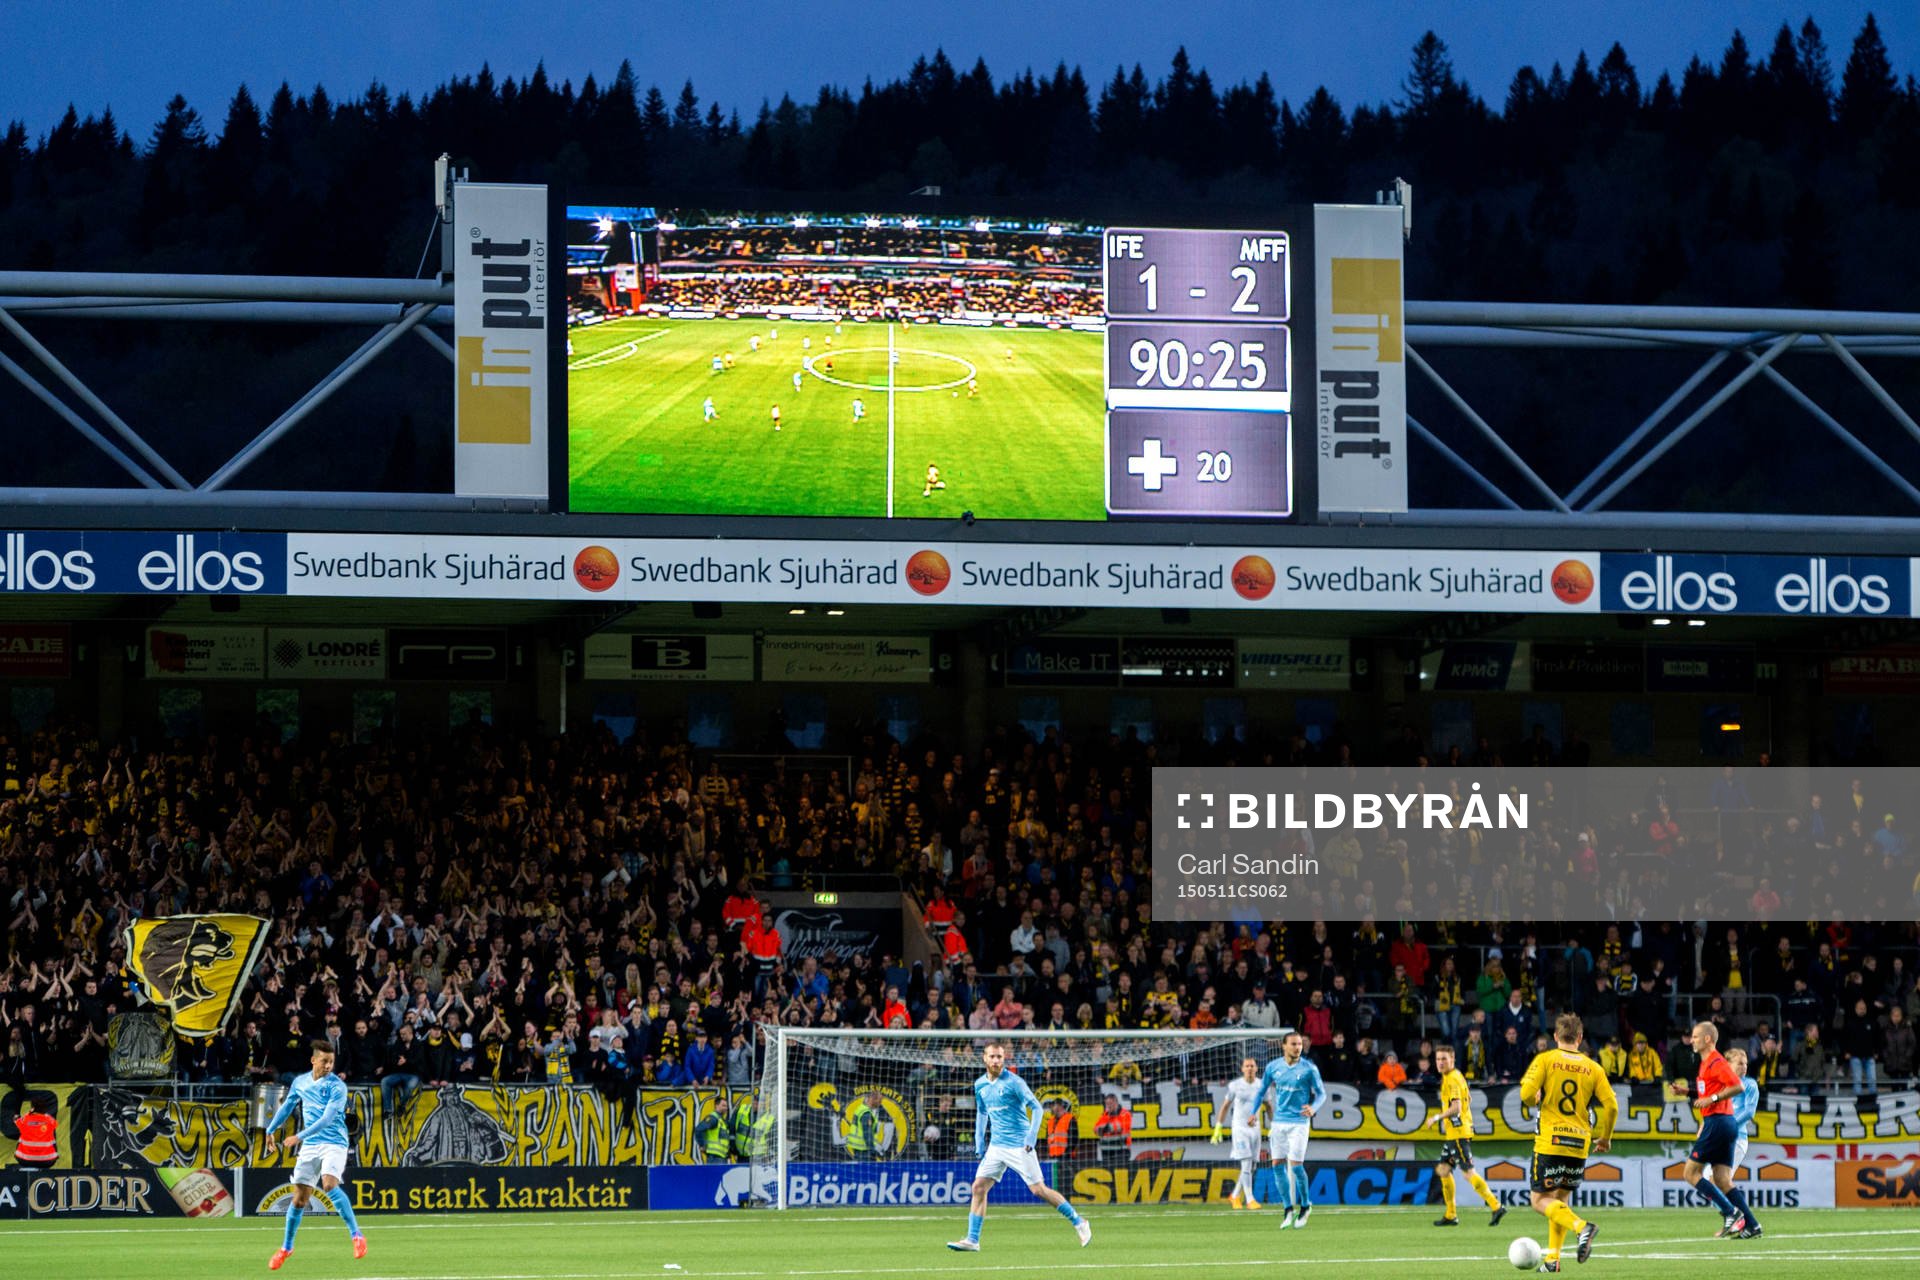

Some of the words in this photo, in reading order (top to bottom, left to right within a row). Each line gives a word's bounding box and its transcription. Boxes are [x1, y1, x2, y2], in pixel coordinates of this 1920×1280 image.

[1109, 235, 1144, 258] IFE
[1240, 238, 1286, 261] MFF
[533, 238, 545, 311] interiör
[1138, 264, 1157, 310] 1
[1231, 266, 1259, 312] 2
[1129, 339, 1267, 389] 90:25
[1320, 388, 1330, 459] interiör
[1196, 451, 1232, 481] 20
[0, 533, 96, 591] llos
[137, 534, 264, 592] ellos
[293, 551, 437, 579] Swedbank
[444, 554, 565, 586] Sjuhärad
[630, 556, 772, 583] Swedbank
[779, 558, 897, 590] Sjuhärad
[961, 560, 1100, 587] Swedbank
[1107, 563, 1223, 594] Sjuhärad
[1286, 565, 1422, 591] Swedbank
[1429, 567, 1543, 599] Sjuhärad
[1621, 555, 1738, 611] ellos
[1775, 558, 1891, 614] ellos
[307, 638, 380, 656] LONDRÉ
[1025, 654, 1081, 671] Make
[1089, 653, 1112, 671] IT
[1450, 662, 1500, 679] KPMG
[1552, 1062, 1592, 1077] PULSEN
[1558, 1079, 1578, 1116] 8
[28, 1175, 154, 1213] CIDER
[352, 1180, 399, 1209] En
[408, 1178, 488, 1209] stark
[496, 1177, 632, 1209] karaktär
[788, 1171, 973, 1205] Björnkläde
